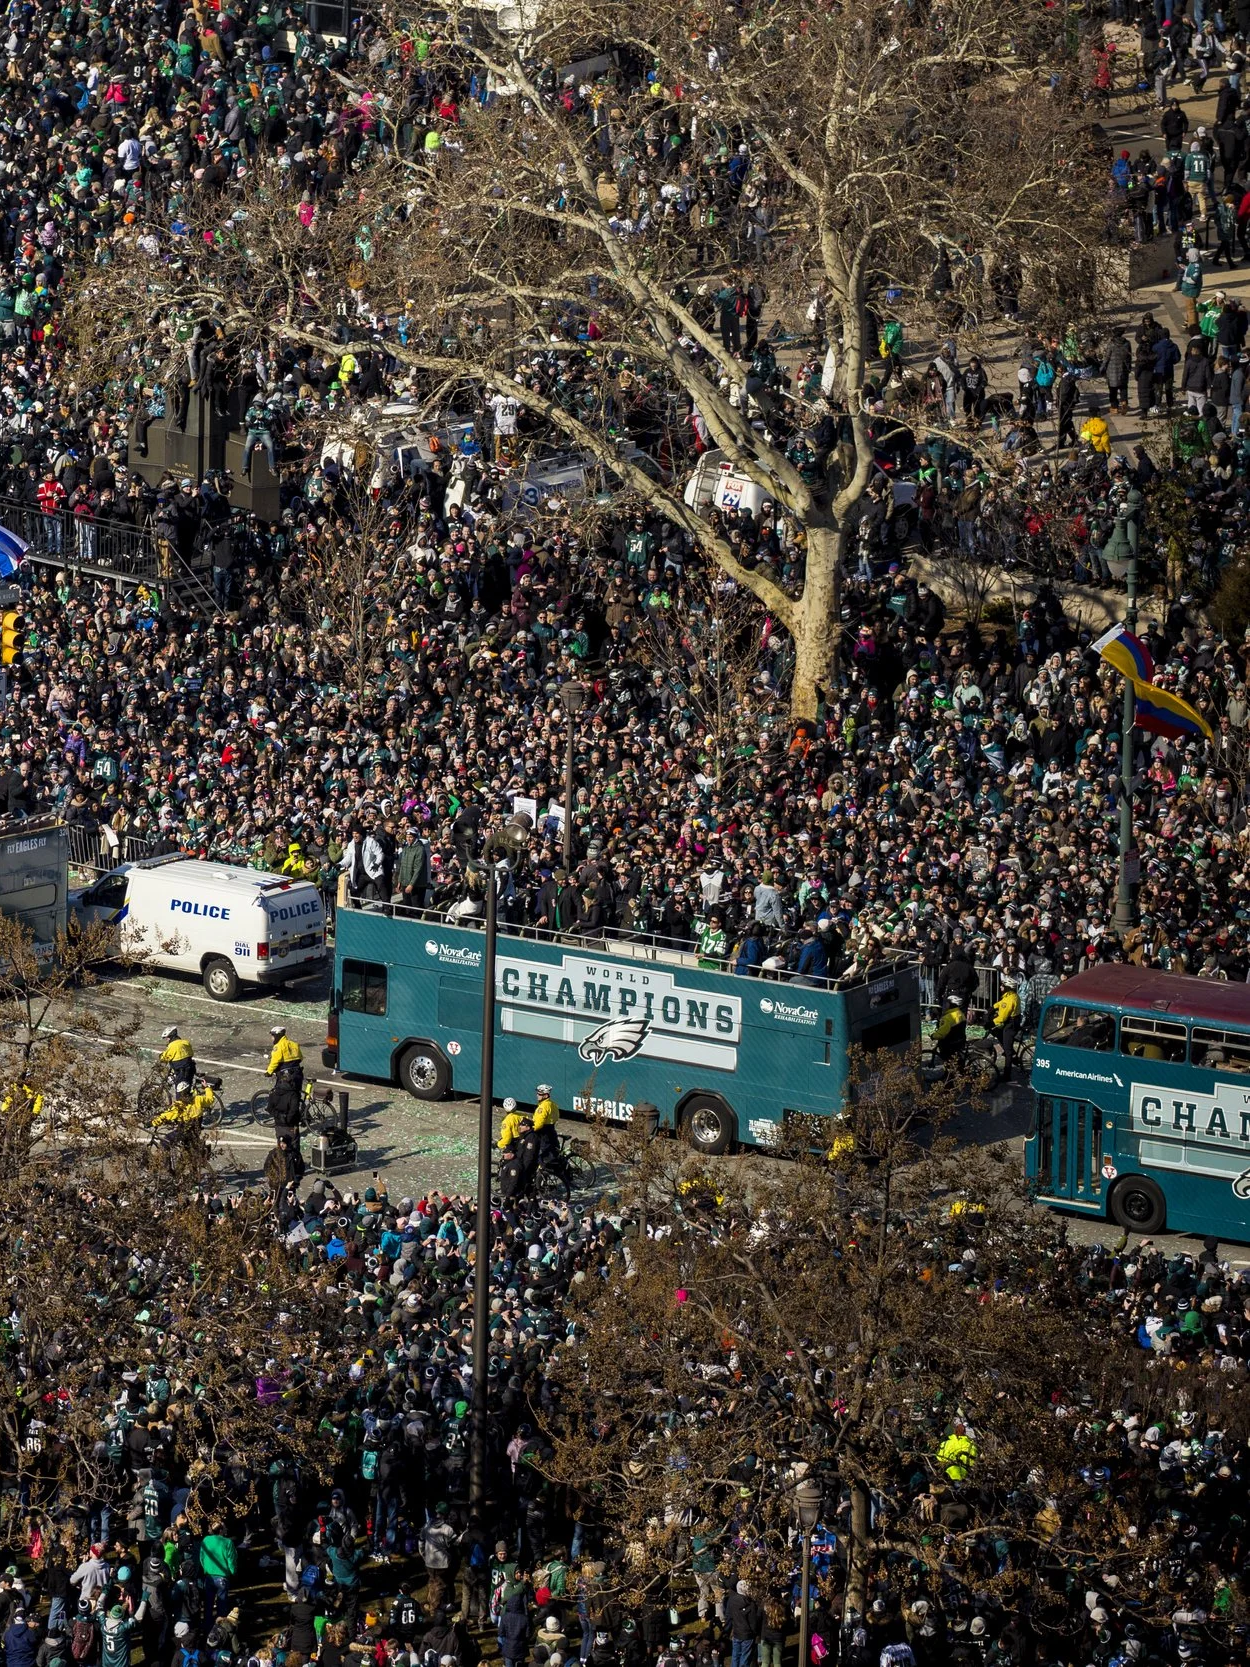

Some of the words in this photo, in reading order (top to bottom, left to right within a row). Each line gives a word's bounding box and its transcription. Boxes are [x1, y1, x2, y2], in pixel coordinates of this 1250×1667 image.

[1193, 160, 1204, 173] 11
[726, 480, 744, 493] FOX
[524, 488, 539, 505] 3
[723, 493, 741, 506] 29
[630, 539, 643, 553] 54
[96, 761, 111, 776] 54
[7, 844, 16, 854] FLY
[15, 838, 38, 853] EAGLES
[38, 837, 47, 847] FLY
[170, 898, 231, 921] POLICE
[270, 900, 320, 924] POLICE
[234, 948, 250, 957] 911
[438, 943, 482, 961] NovaCare
[702, 936, 716, 954] 17
[438, 956, 480, 967] REHABILITATION
[586, 966, 650, 985] WORLD
[502, 967, 734, 1034] CHAMPIONS
[773, 1001, 819, 1019] NovaCare
[773, 1014, 817, 1026] REHABILITATION
[1036, 1058, 1050, 1069] 395
[1055, 1068, 1088, 1080] American
[1087, 1072, 1113, 1083] Airlines
[590, 1097, 634, 1121] EAGLES
[26, 1437, 41, 1452] 86
[144, 1498, 159, 1517] 20
[401, 1609, 415, 1625] 86
[106, 1634, 115, 1651] 5
